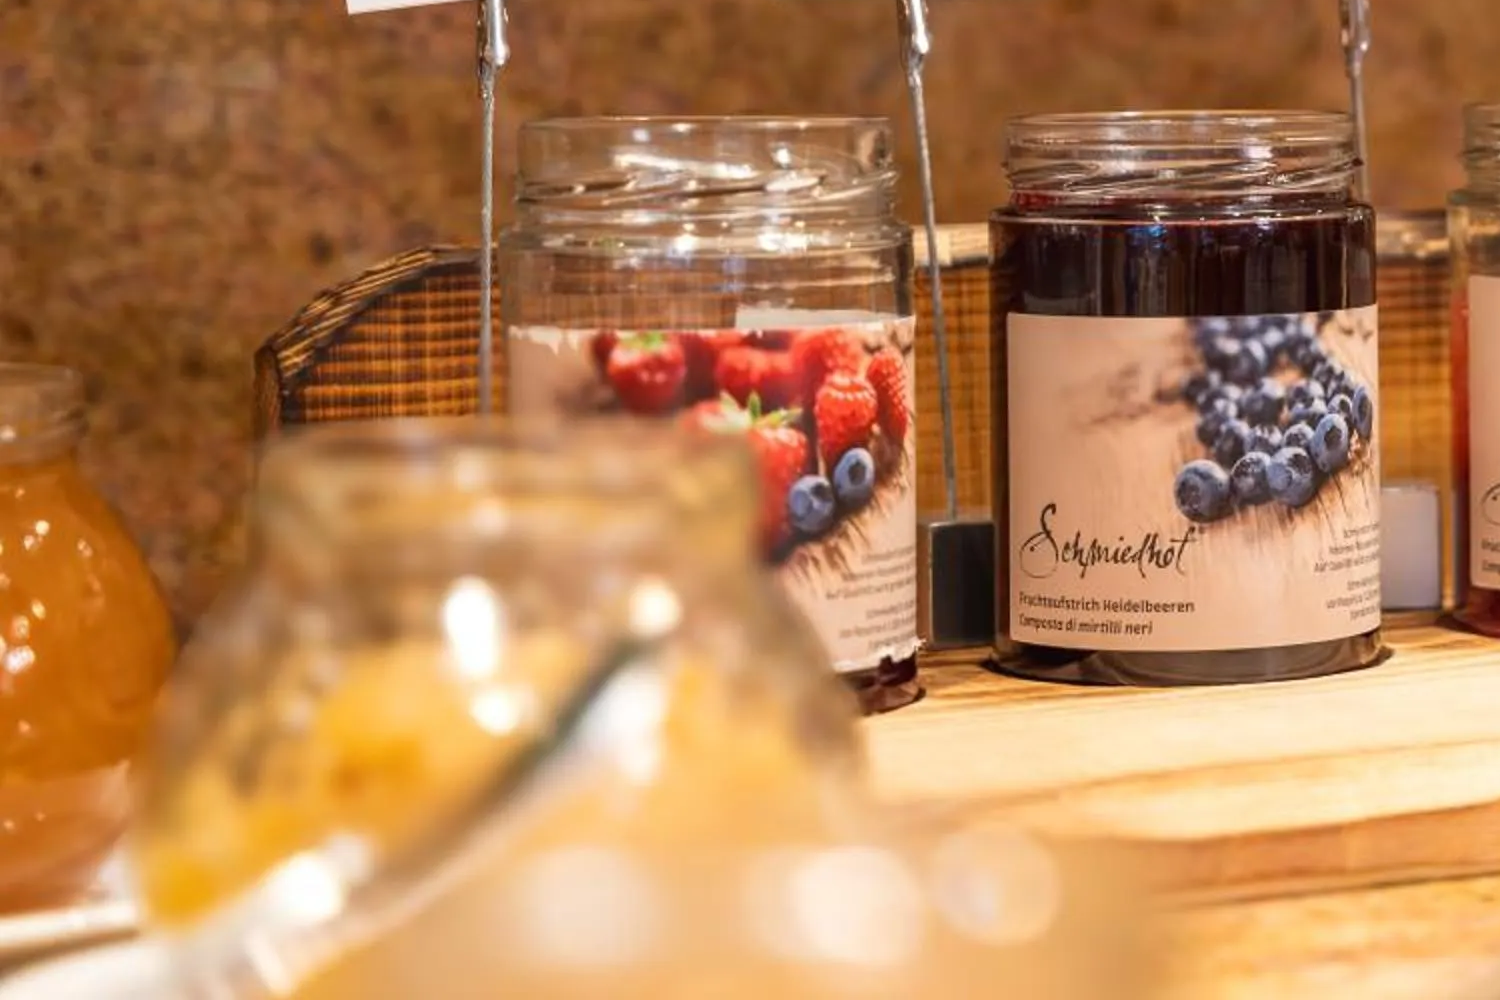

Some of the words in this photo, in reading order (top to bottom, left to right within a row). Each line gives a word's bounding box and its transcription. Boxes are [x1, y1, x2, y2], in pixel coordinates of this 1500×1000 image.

[1020, 503, 1198, 579] Schmiedhof
[1103, 599, 1195, 613] Heidelbeeren
[1125, 620, 1153, 635] neri
